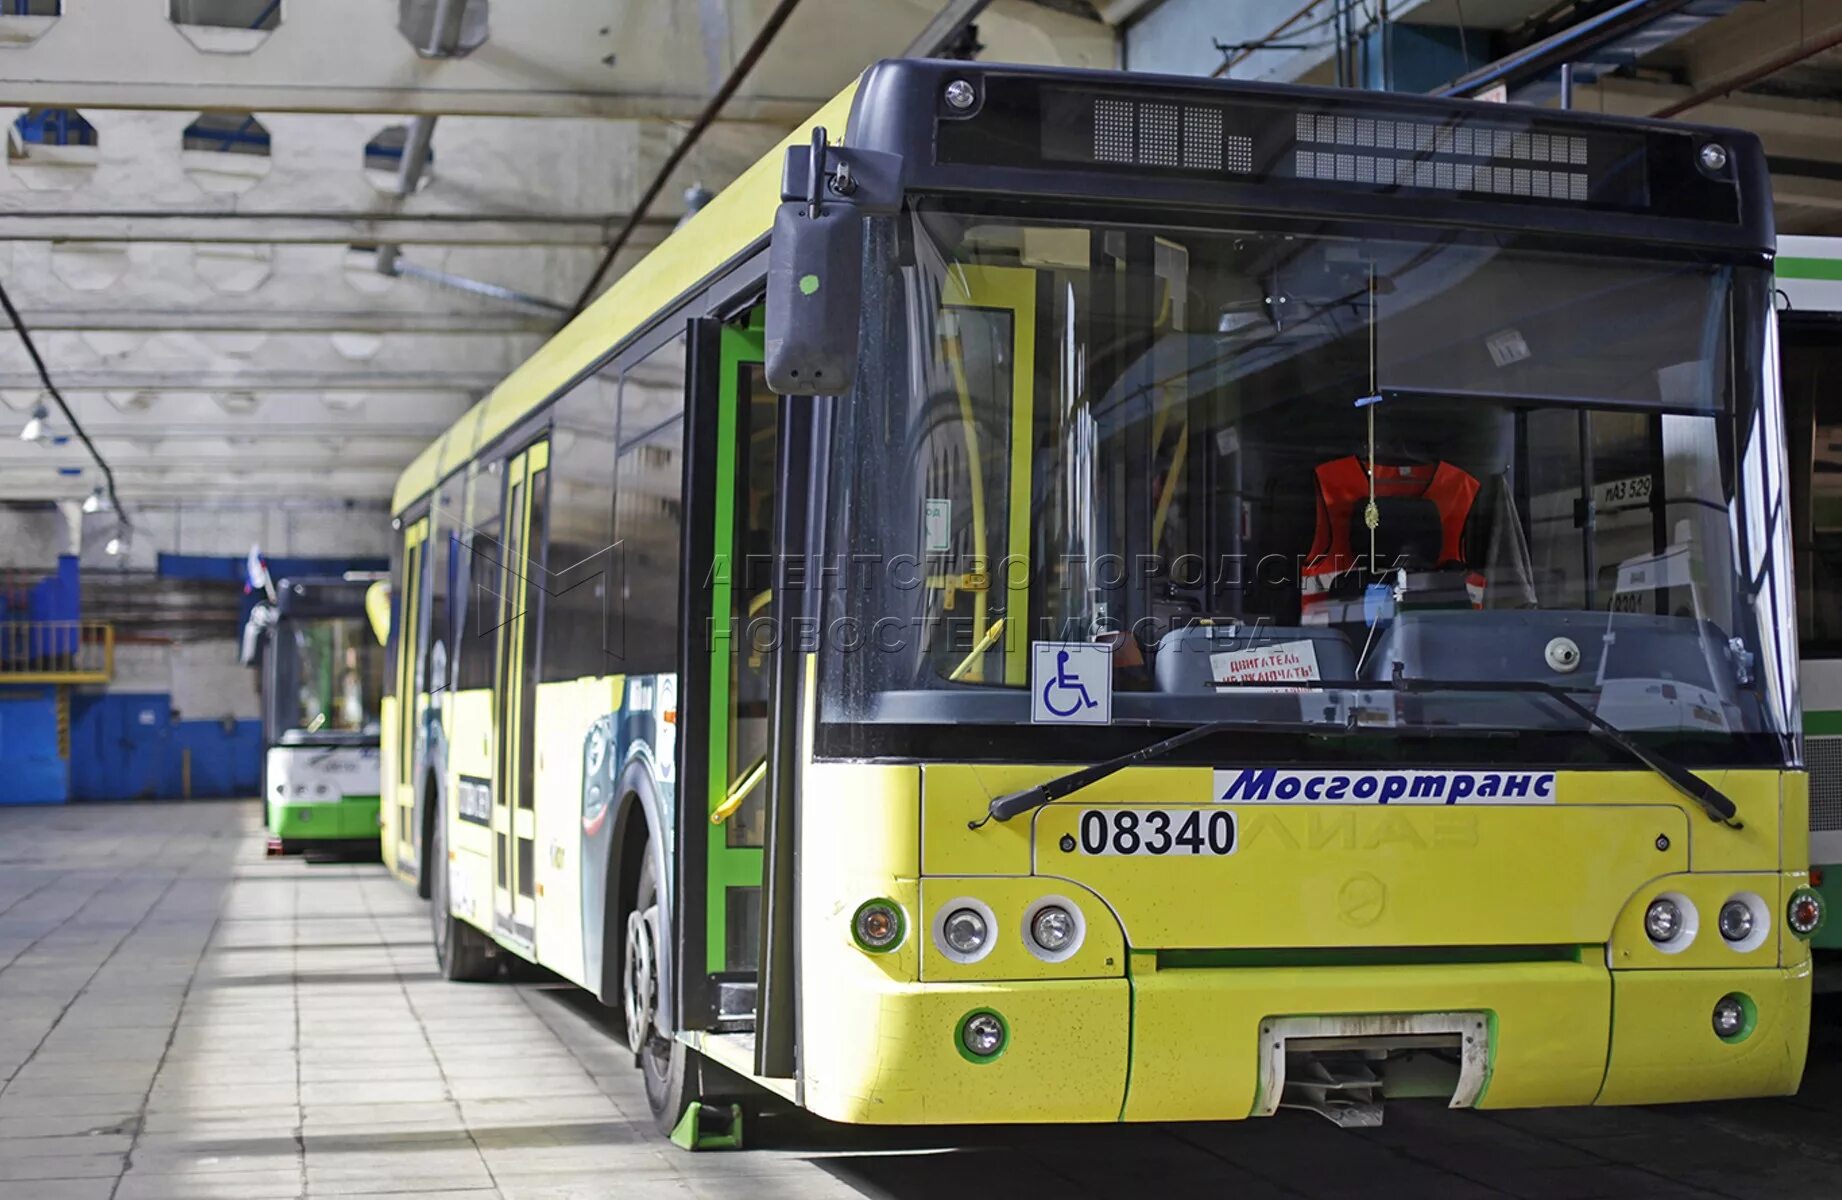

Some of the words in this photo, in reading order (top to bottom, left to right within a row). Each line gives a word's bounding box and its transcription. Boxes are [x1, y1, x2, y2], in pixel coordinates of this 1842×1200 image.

[1230, 653, 1301, 673] ДВИГАТЕЛЬ
[1221, 768, 1555, 805] Мосгортранс
[1080, 809, 1236, 855] 08340
